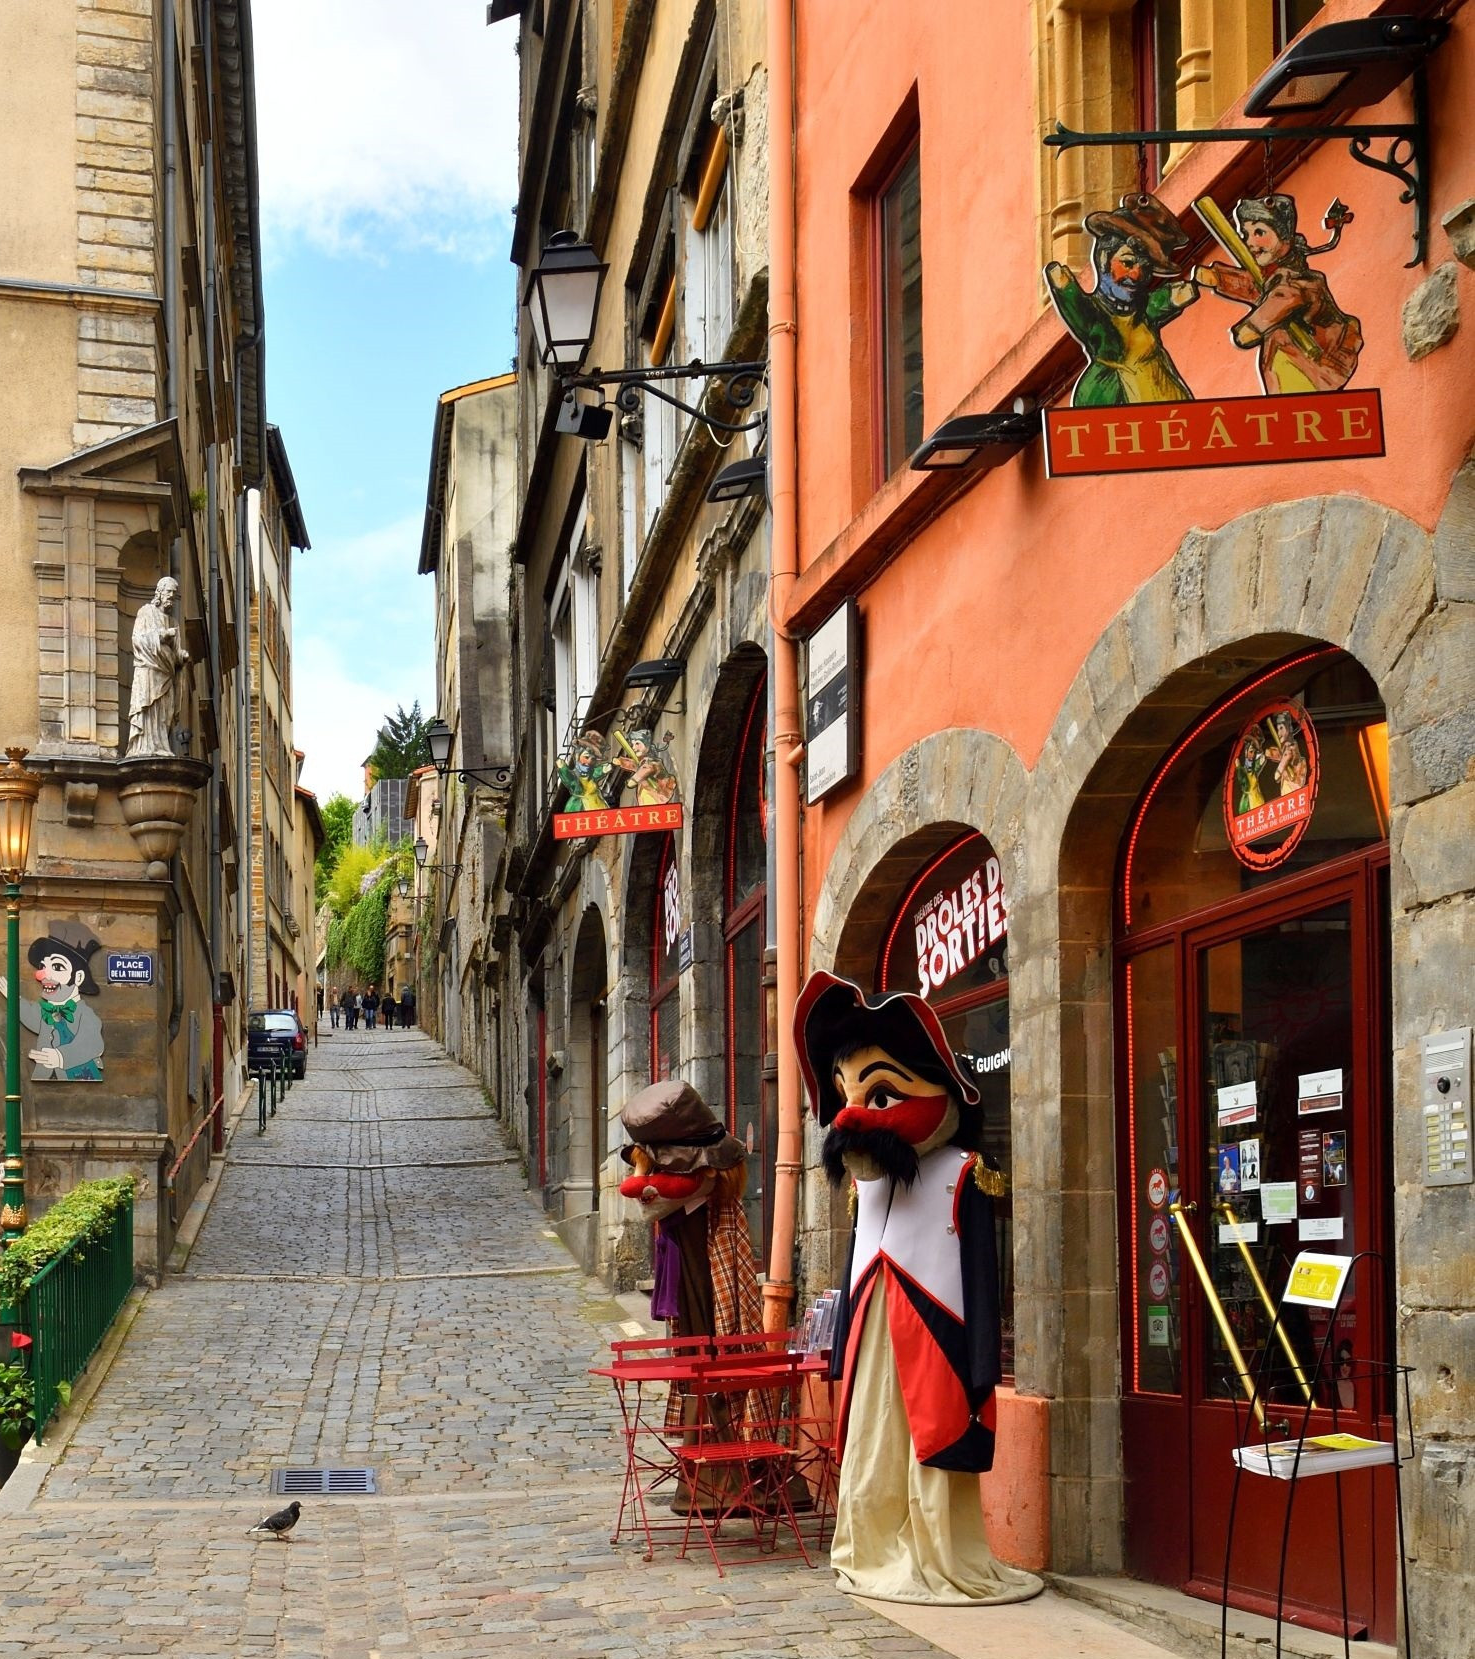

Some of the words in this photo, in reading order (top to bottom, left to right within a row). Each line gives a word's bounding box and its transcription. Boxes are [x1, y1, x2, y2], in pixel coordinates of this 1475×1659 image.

[1057, 407, 1372, 458] THÉÂTRE
[557, 810, 679, 833] THÉÂTRE
[1237, 793, 1305, 832] THÉÂTRE
[1237, 830, 1246, 841] LA
[1245, 823, 1269, 839] MAISON
[1278, 808, 1307, 824] GUIGNOL
[933, 890, 944, 908] DES
[110, 970, 119, 978] DE
[119, 970, 126, 978] LA
[128, 969, 149, 978] TRINITÉ
[116, 961, 144, 969] PLACE
